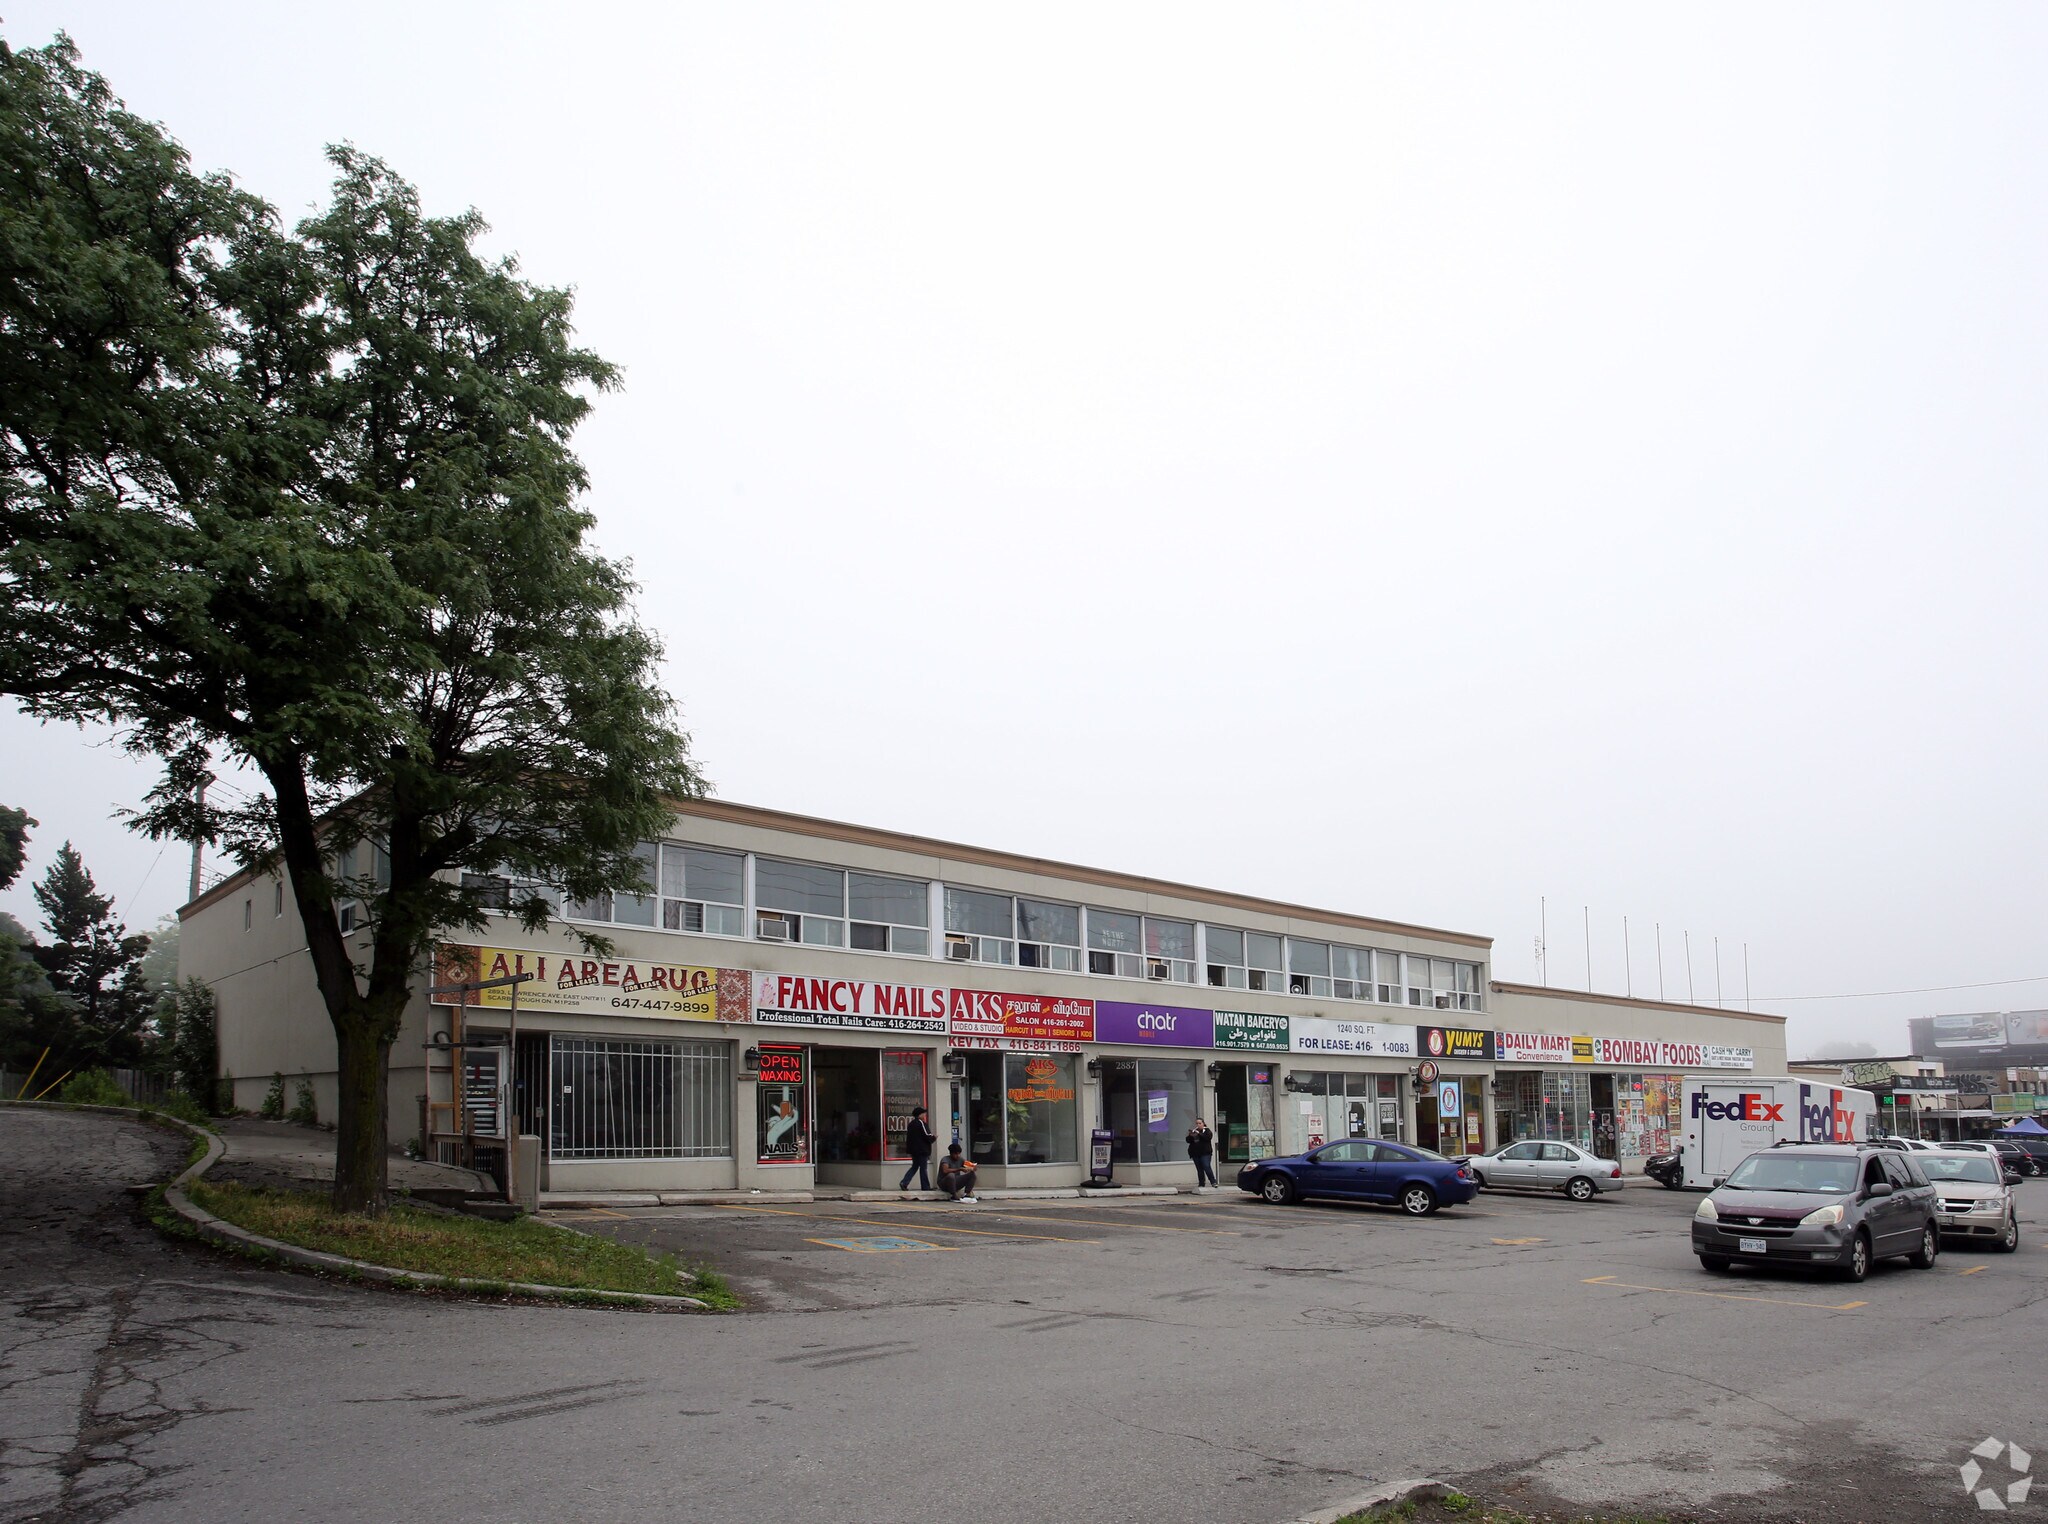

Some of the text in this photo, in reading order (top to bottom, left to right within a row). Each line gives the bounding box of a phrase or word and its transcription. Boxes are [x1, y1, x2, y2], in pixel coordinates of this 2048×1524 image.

[489, 952, 711, 992] ALI AREA RUG
[559, 977, 598, 989] FOR LEASE
[624, 980, 660, 992] FOR LEASE
[508, 990, 546, 998] LWRENCE
[683, 984, 717, 998] FOR LEASE
[777, 975, 946, 1019] FANCY NAILS
[487, 995, 540, 1003] SCARBROUGH
[611, 997, 710, 1013] 647-447-9899
[952, 991, 1003, 1021] AKS
[759, 1011, 944, 1031] Professional Total Nails Care: 416-264-2542
[954, 1022, 973, 1031] VIDEO
[980, 1024, 1003, 1033] STUDIO
[1015, 1017, 1040, 1025] SALON
[1137, 1011, 1177, 1031] chatr
[1215, 1012, 1279, 1030] WATAN BAKERY
[1005, 1026, 1029, 1034] HAIRCUT
[1052, 1029, 1075, 1037] SENIORS
[1337, 1024, 1352, 1033] 1240
[948, 1037, 1081, 1052] KEV TAX 416-841-1866
[1299, 1037, 1319, 1049] FOR
[1321, 1039, 1353, 1050] LEASE:
[1445, 1030, 1484, 1056] YUMYS
[1505, 1033, 1571, 1051] DAILY MART
[1516, 1051, 1563, 1061] Convenience
[1602, 1039, 1701, 1066] BOMBAY FOODS
[1711, 1046, 1726, 1055] CASH
[1735, 1048, 1752, 1057] CARRY
[760, 1054, 800, 1068] OPEN
[1029, 1059, 1055, 1070] AKS
[1115, 1061, 1136, 1070] 2887
[759, 1070, 802, 1082] WAXING
[1691, 1092, 1785, 1122] FedEx
[1800, 1083, 1856, 1142] FedEx
[1740, 1122, 1774, 1132] Ground
[764, 1142, 799, 1154] NAILS
